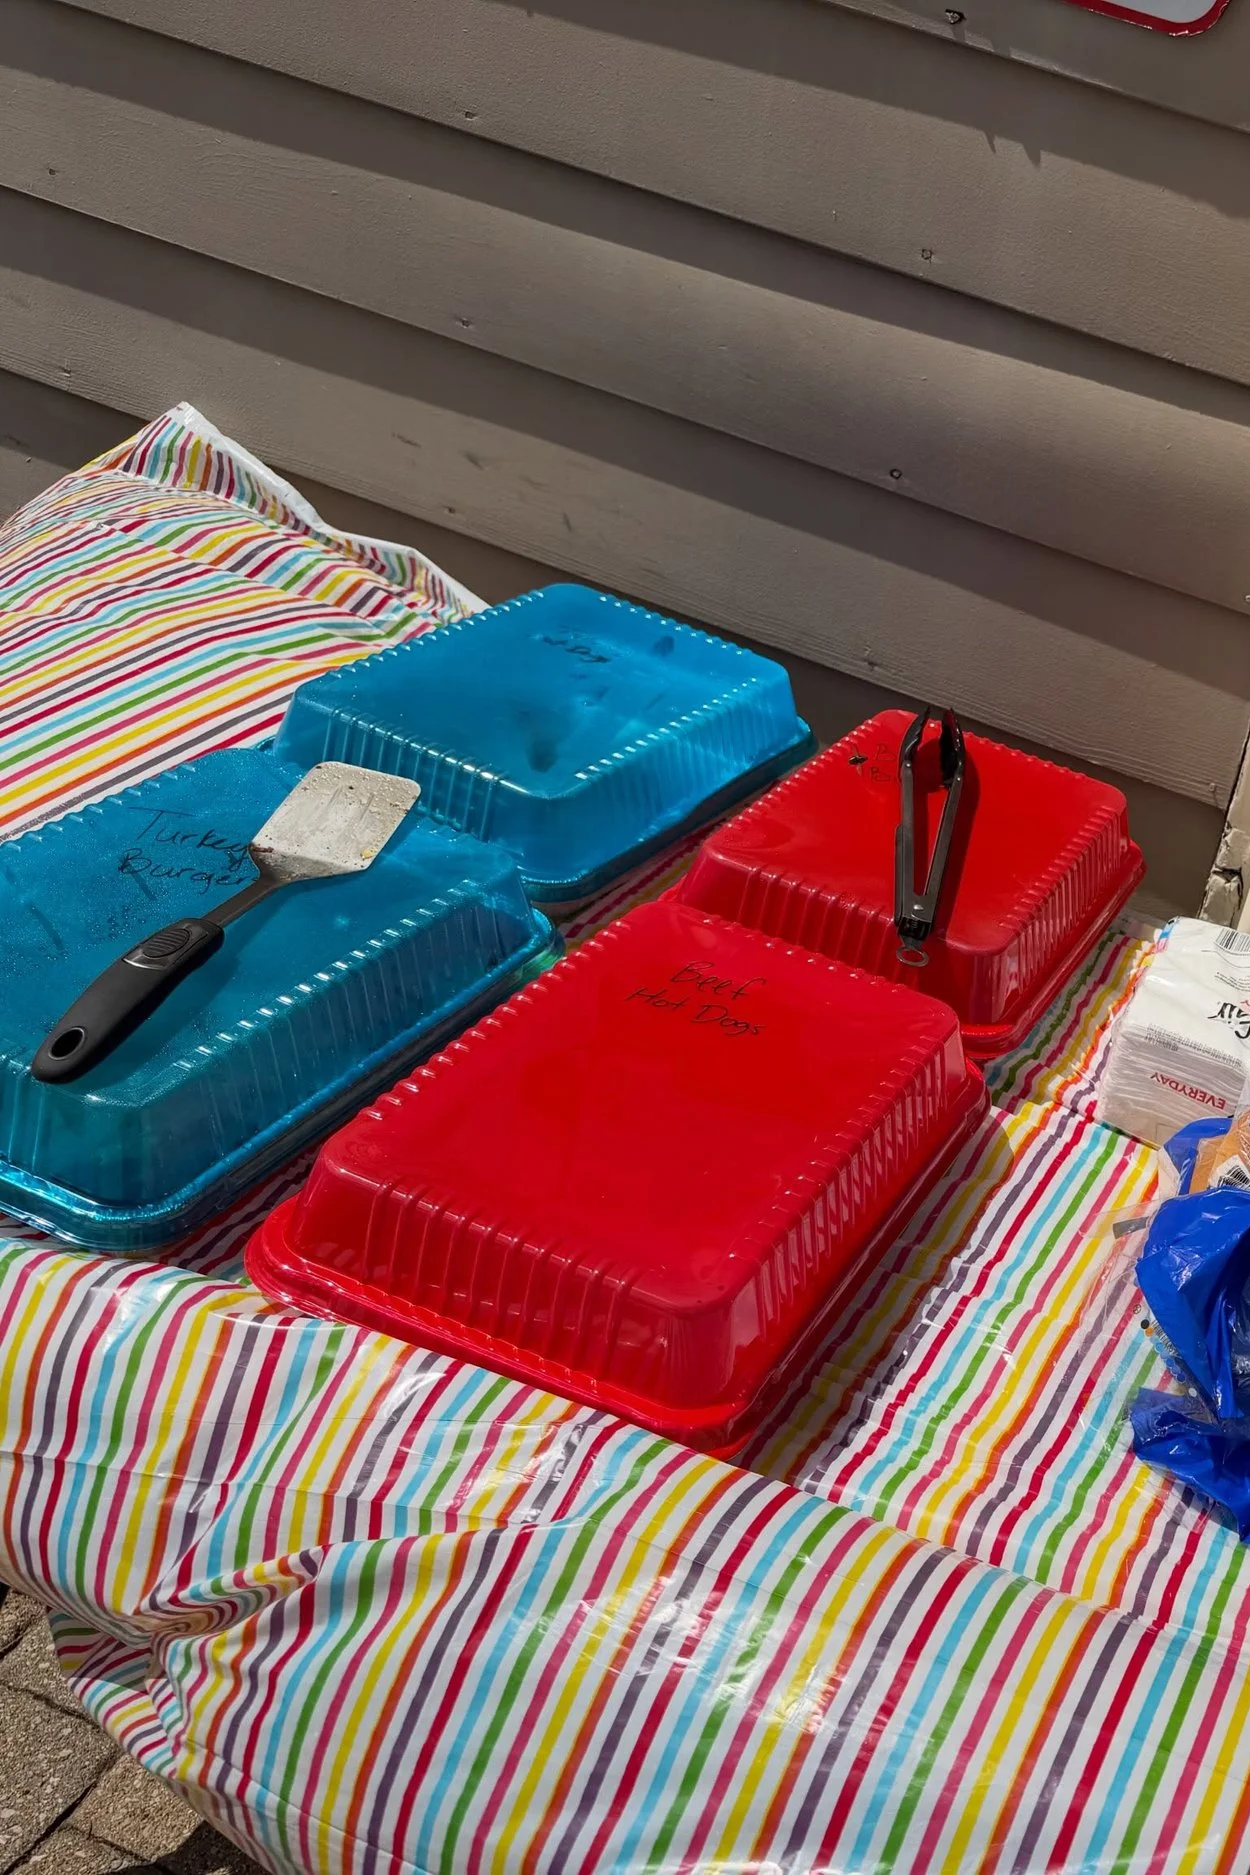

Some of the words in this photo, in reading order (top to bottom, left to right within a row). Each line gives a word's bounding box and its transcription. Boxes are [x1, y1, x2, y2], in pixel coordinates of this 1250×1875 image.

[670, 961, 767, 1000] Beef
[624, 987, 689, 1010] Hot
[691, 1004, 767, 1035] Dogs
[1150, 1072, 1226, 1110] EVERYDAY
